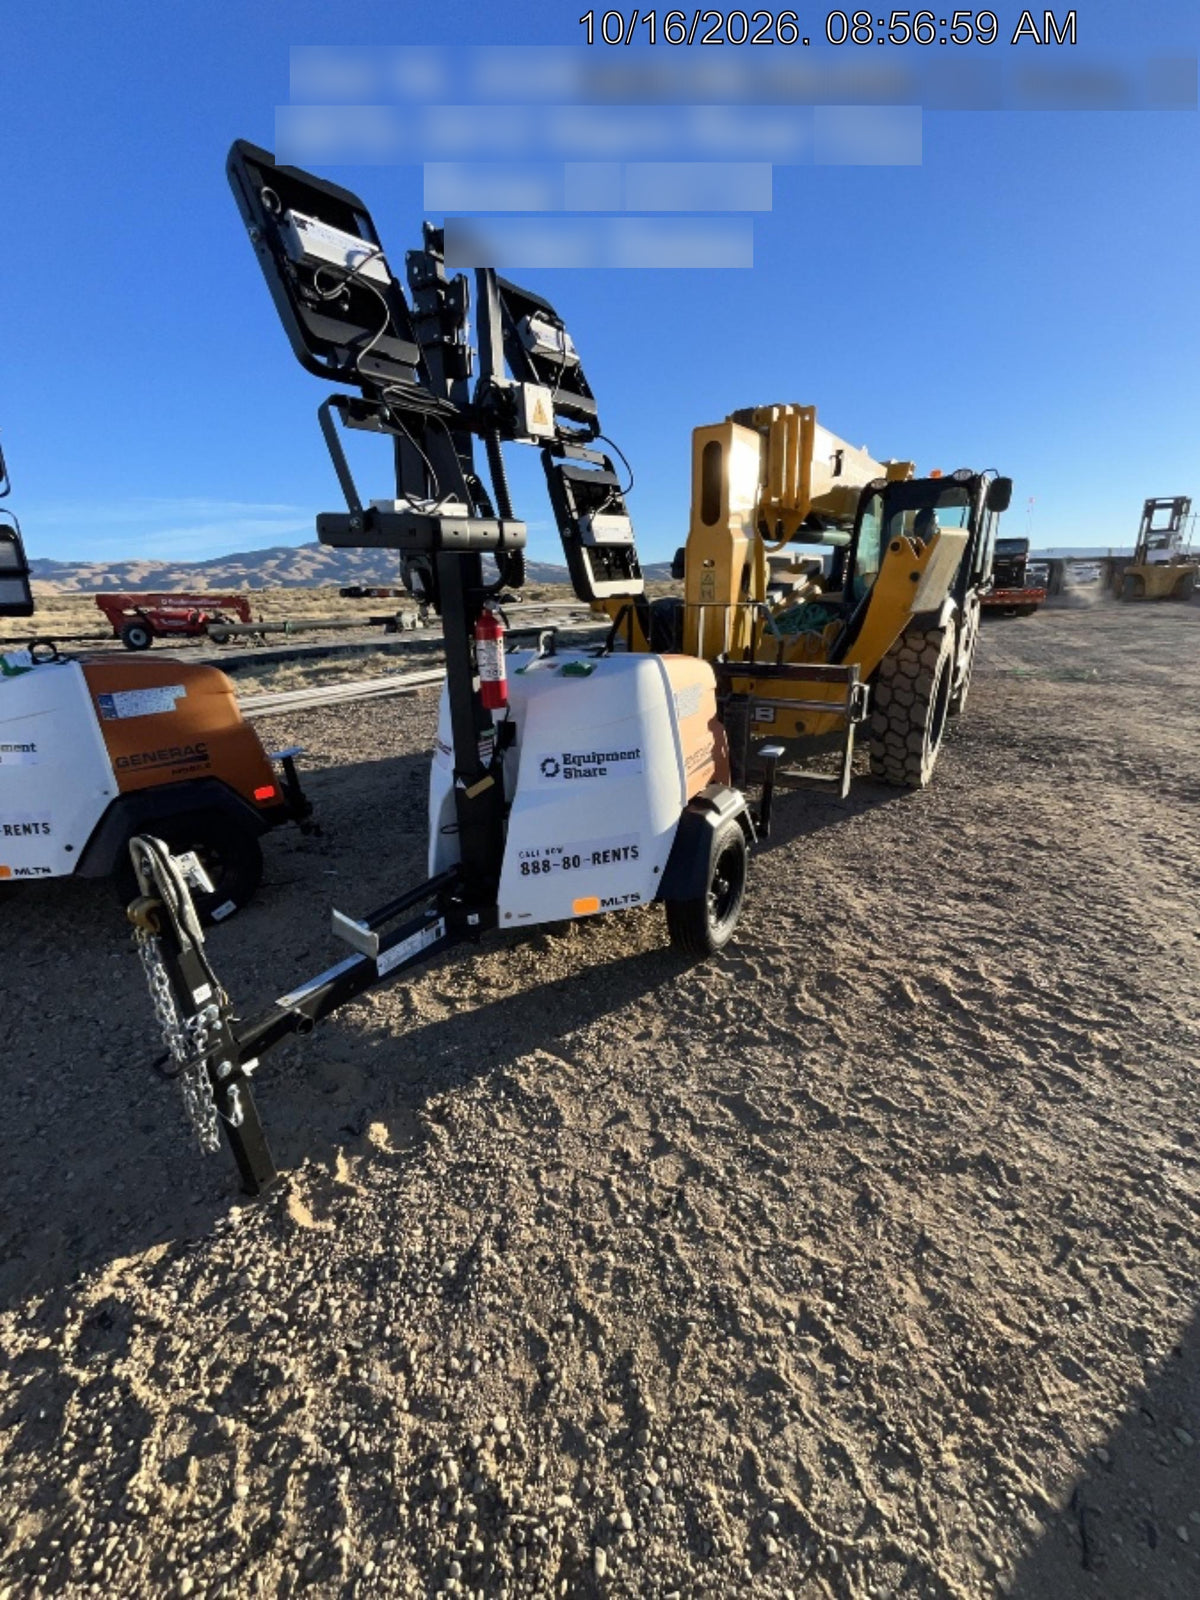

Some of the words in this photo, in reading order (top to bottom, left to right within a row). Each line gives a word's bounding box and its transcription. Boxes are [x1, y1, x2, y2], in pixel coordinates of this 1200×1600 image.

[115, 742, 207, 769] GENERAC
[562, 748, 640, 767] Equipment
[563, 767, 607, 779] Share
[520, 845, 640, 876] 888-80-RENTS
[600, 892, 641, 908] MLTS
